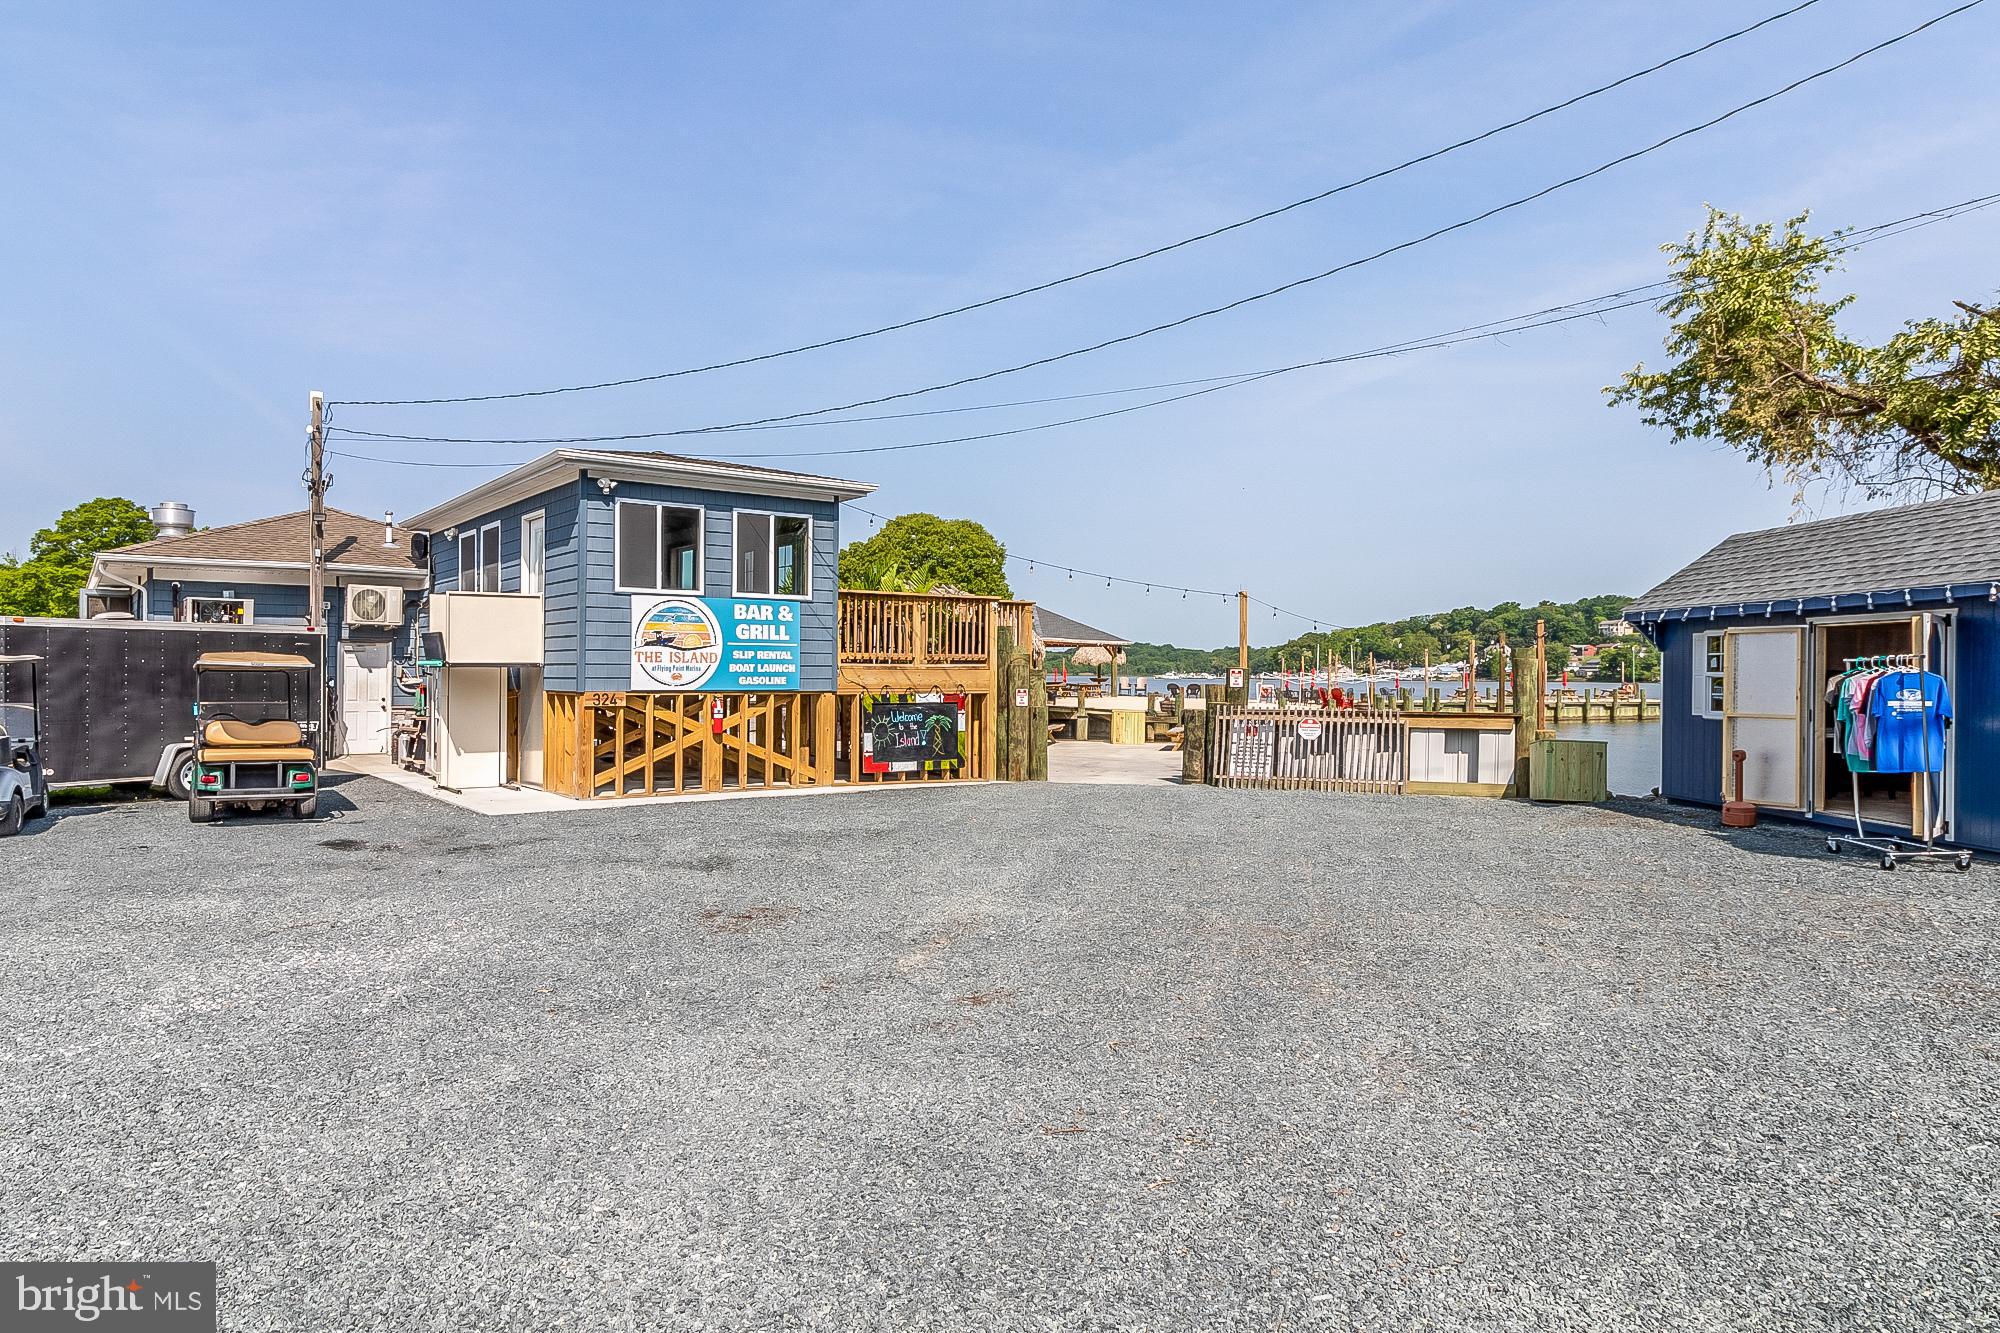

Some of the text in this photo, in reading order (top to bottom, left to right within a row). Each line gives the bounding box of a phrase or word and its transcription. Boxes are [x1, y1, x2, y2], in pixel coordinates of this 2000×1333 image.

[734, 604, 794, 622] BAR &
[735, 624, 790, 641] GRILL
[634, 651, 718, 664] THE ISLAND
[733, 651, 793, 660] SLIP RENTAL
[657, 665, 672, 673] Flying
[729, 664, 796, 673] BOAT LAUNCH
[739, 676, 787, 685] GASOLINE
[593, 693, 617, 706] 324
[890, 711, 923, 723] Welcome
[899, 722, 918, 731] to the
